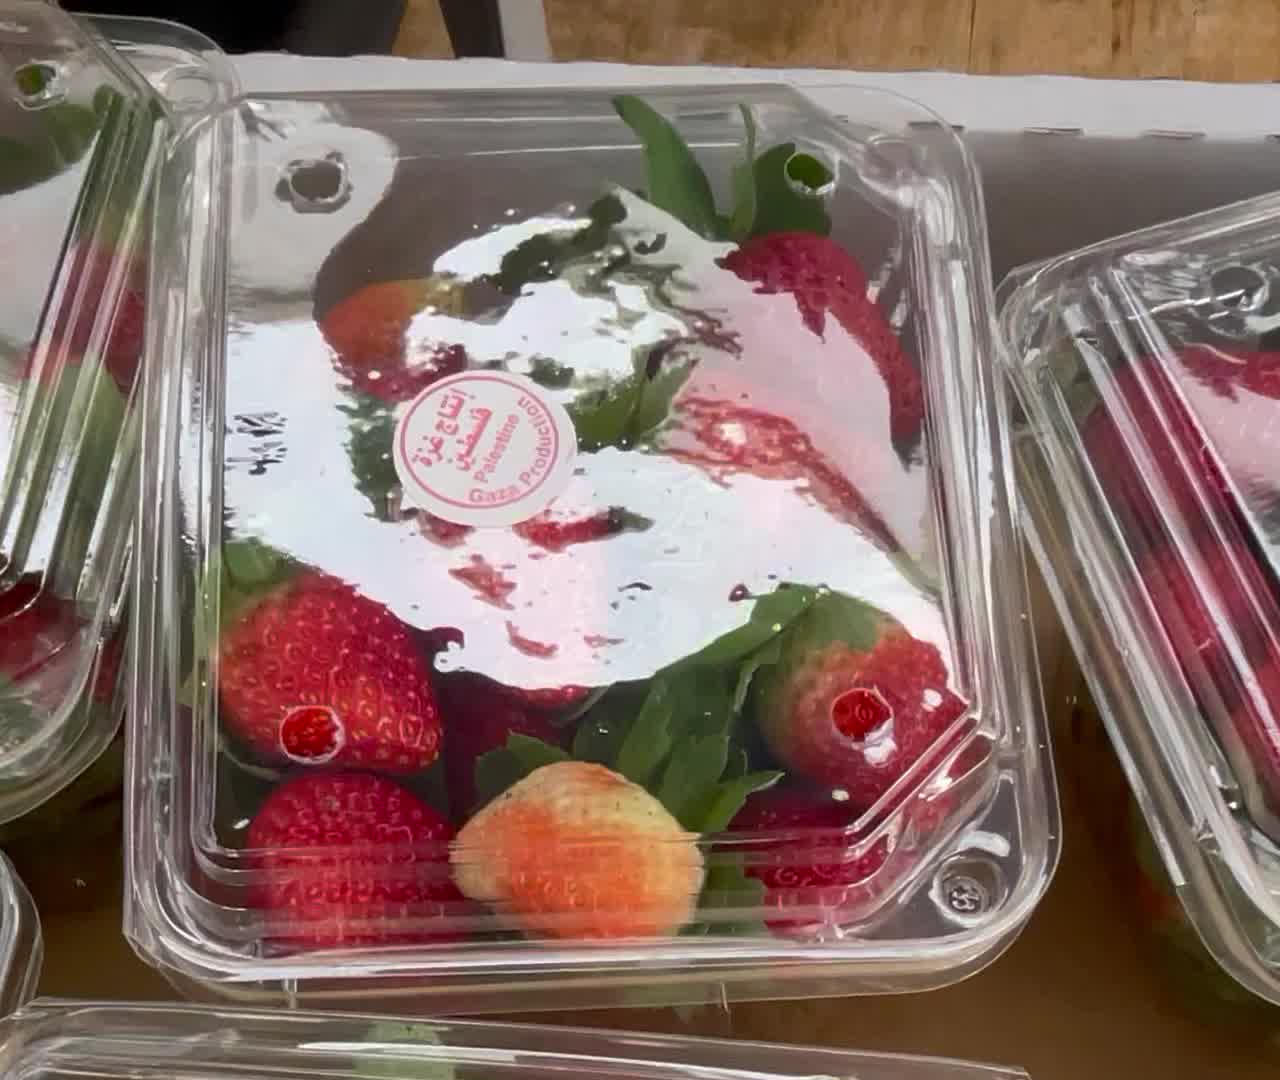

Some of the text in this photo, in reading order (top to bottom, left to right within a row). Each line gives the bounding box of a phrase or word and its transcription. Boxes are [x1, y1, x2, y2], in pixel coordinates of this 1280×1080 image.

[412, 388, 475, 467] إنتاج غزة
[447, 407, 492, 471] فلسطين
[518, 396, 552, 486] Production
